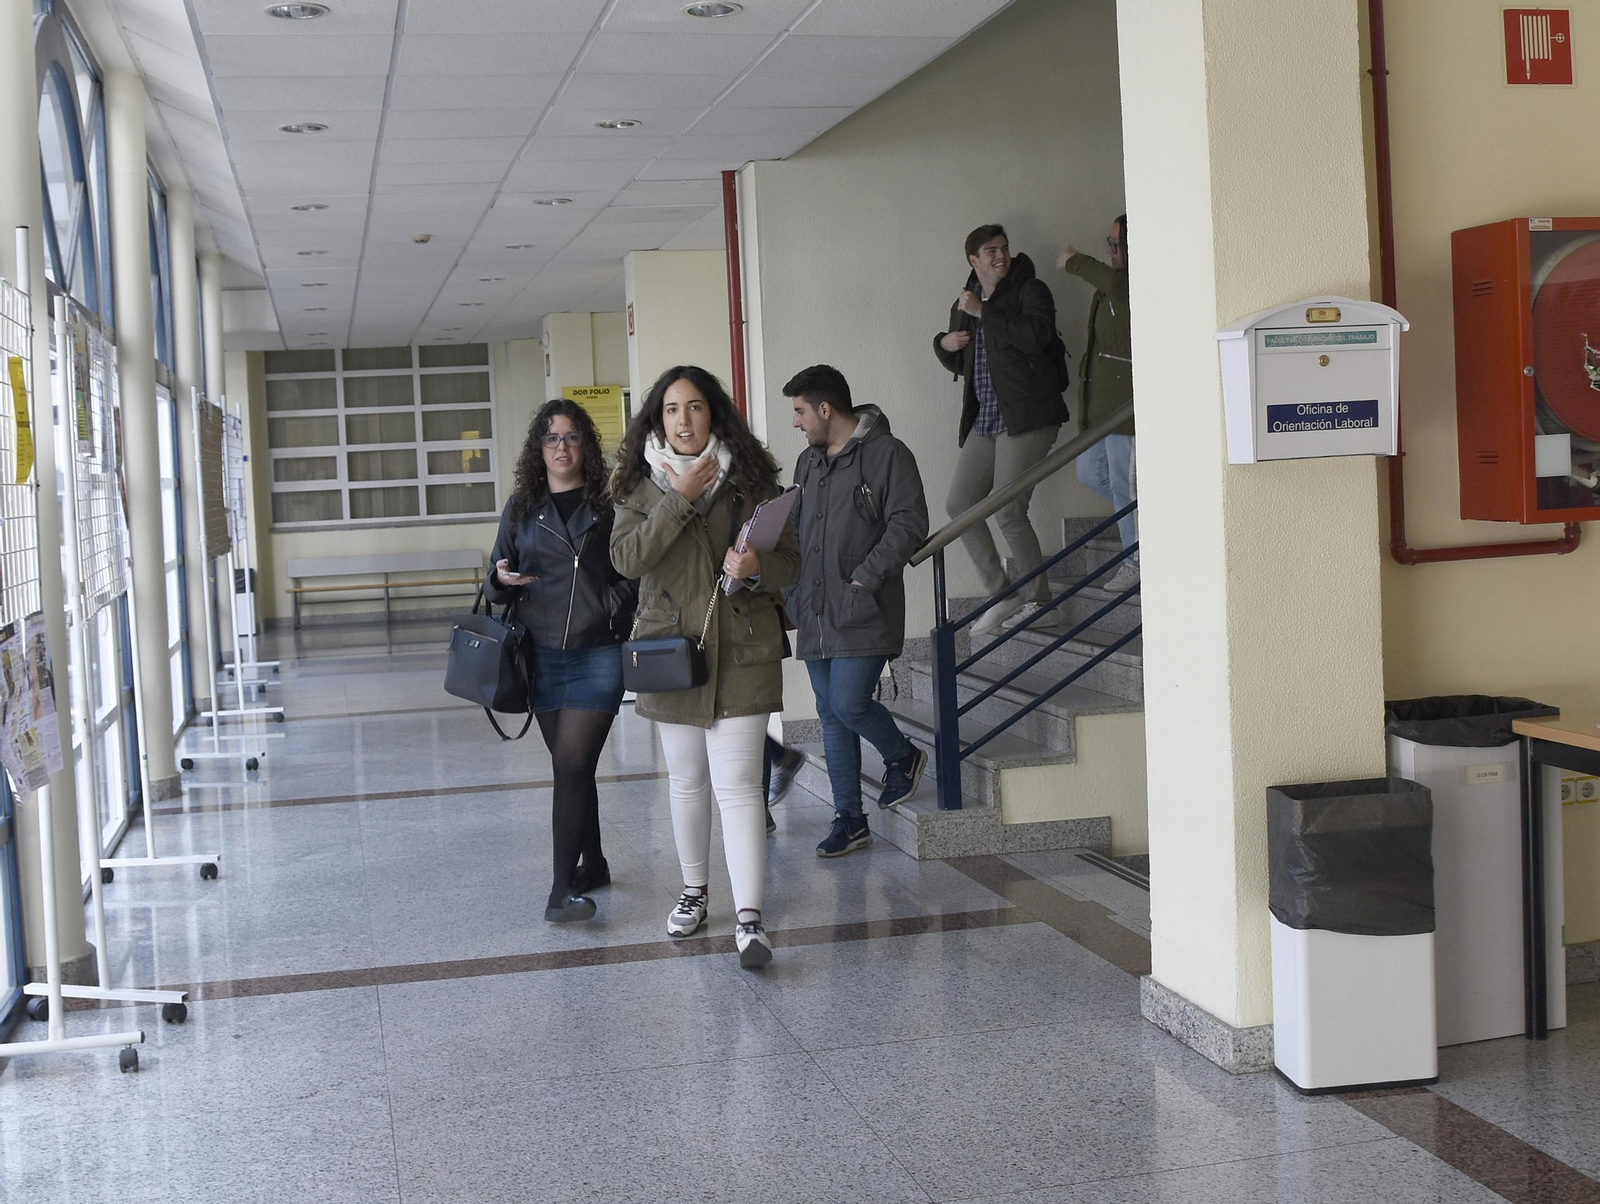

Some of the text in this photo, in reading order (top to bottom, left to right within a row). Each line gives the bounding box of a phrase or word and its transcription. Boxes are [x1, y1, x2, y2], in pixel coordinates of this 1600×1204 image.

[1348, 333, 1375, 341] TRABAJO
[1297, 403, 1349, 416] Oficina de
[1272, 416, 1373, 432] Orientación Laboral
